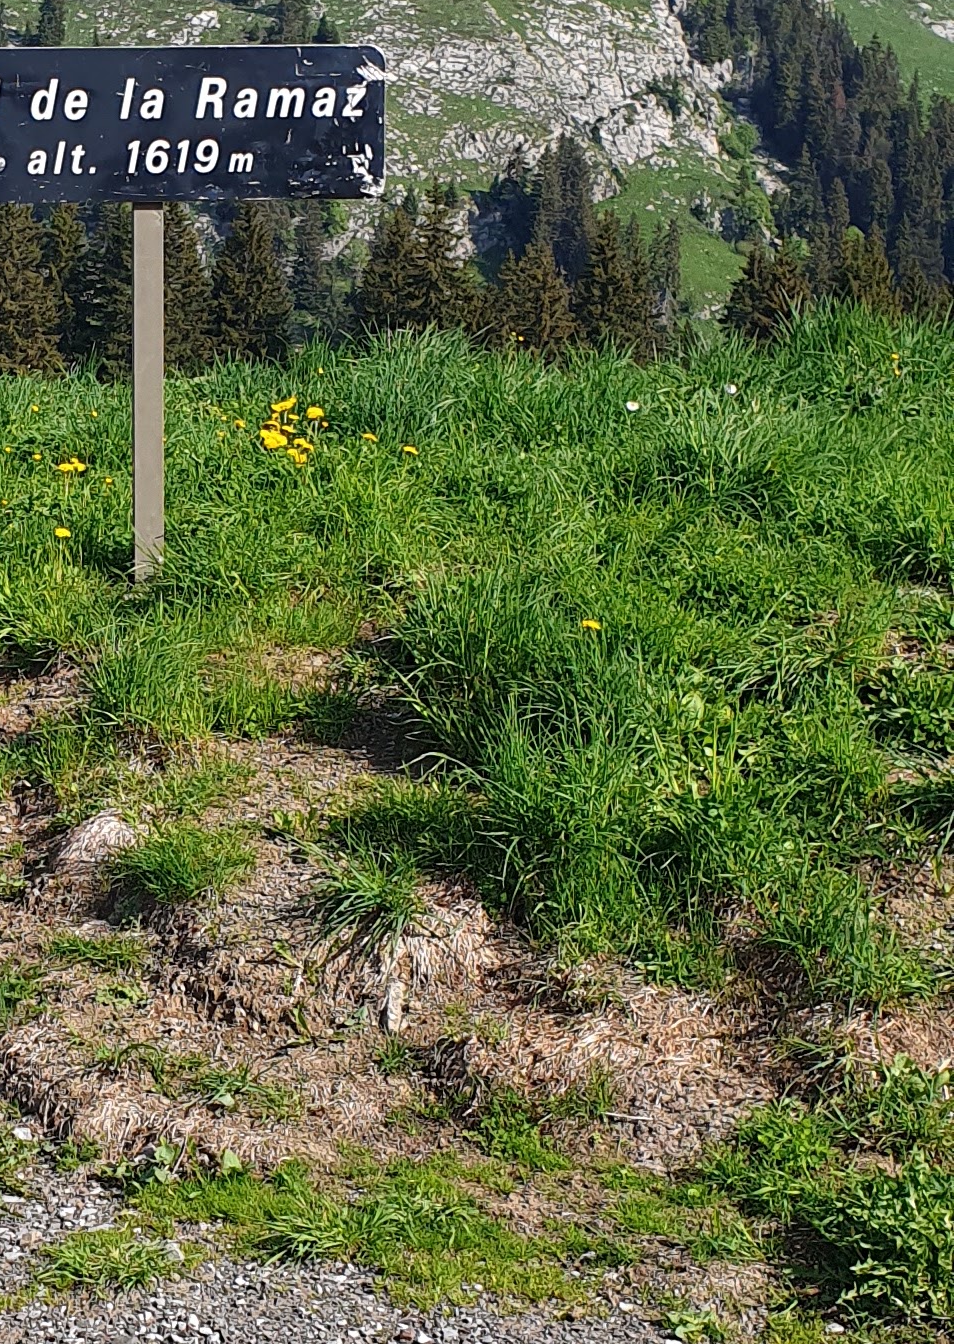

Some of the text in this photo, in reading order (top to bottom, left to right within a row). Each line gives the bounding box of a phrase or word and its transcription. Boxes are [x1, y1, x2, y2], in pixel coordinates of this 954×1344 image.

[31, 78, 88, 120] de
[120, 78, 164, 119] la
[196, 77, 368, 118] Ramaz
[27, 140, 254, 174] alt. 1619 m
